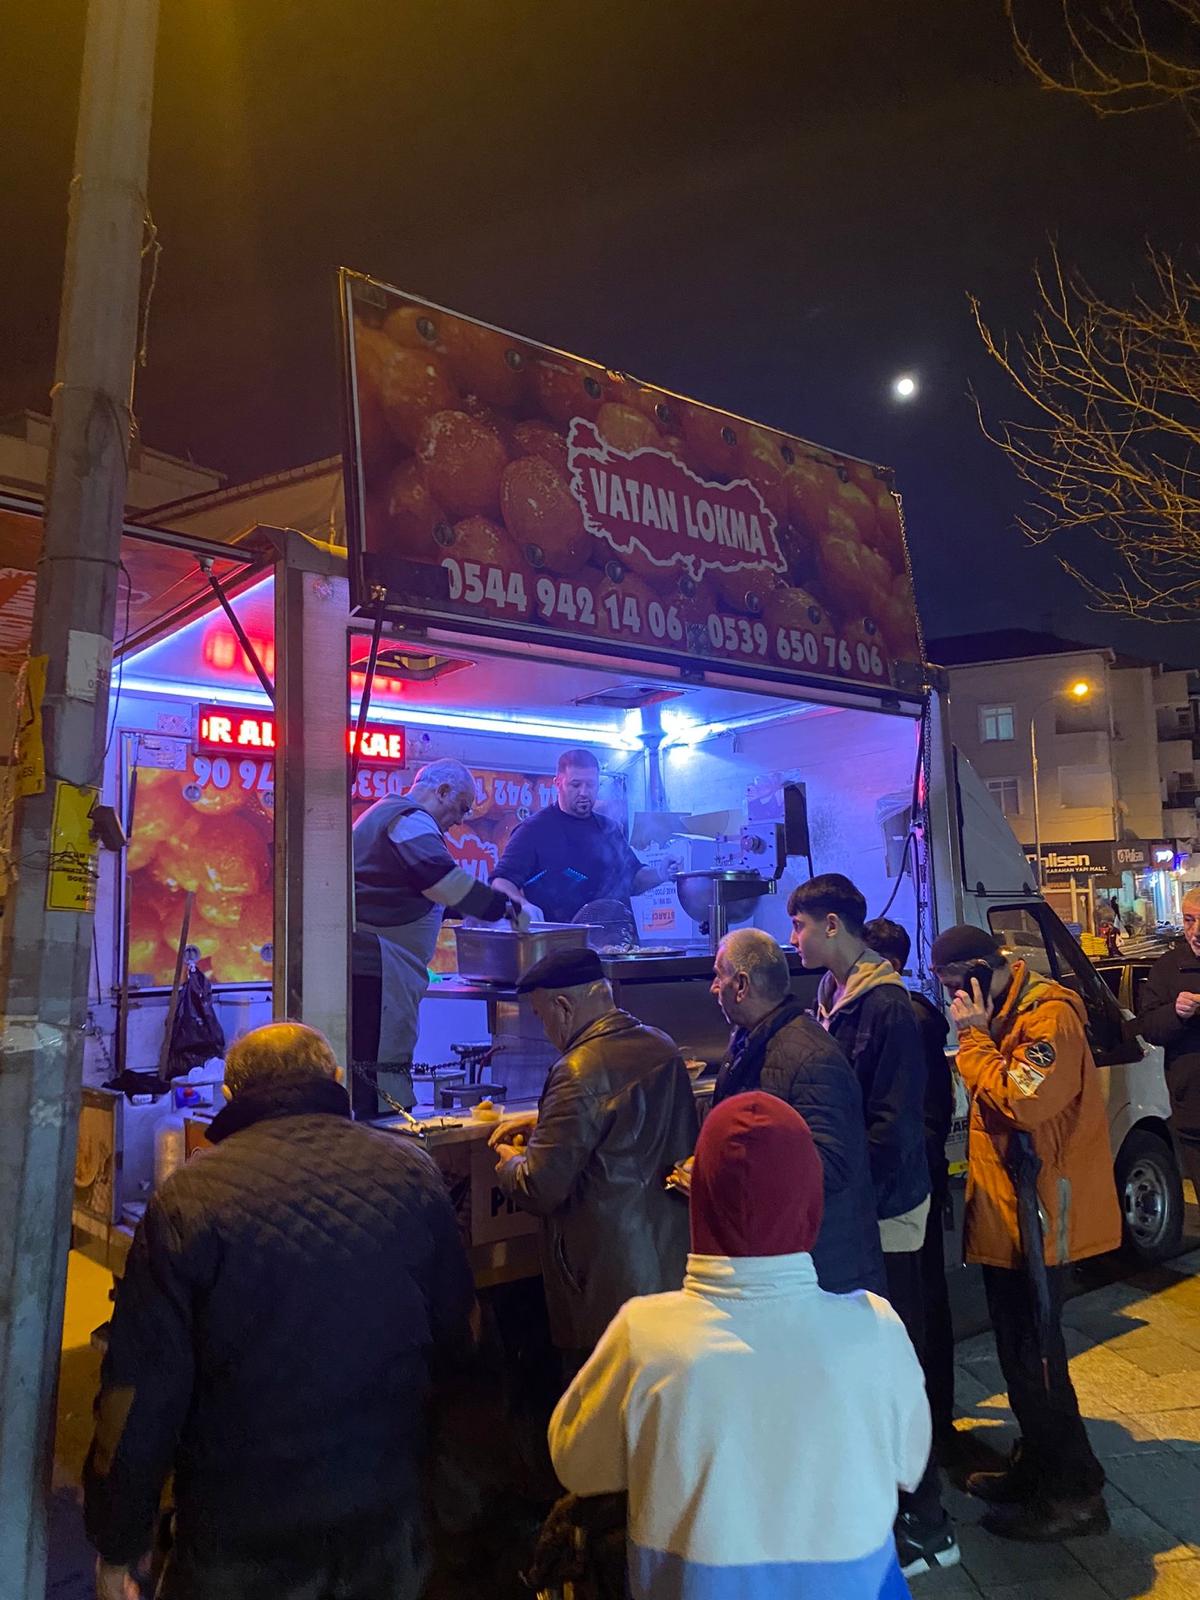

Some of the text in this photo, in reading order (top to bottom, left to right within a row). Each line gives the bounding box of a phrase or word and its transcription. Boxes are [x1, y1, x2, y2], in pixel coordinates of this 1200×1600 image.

[589, 467, 768, 556] VATAN LOKMA
[441, 557, 883, 676] 0544 942 14 06 0539 650 76 06
